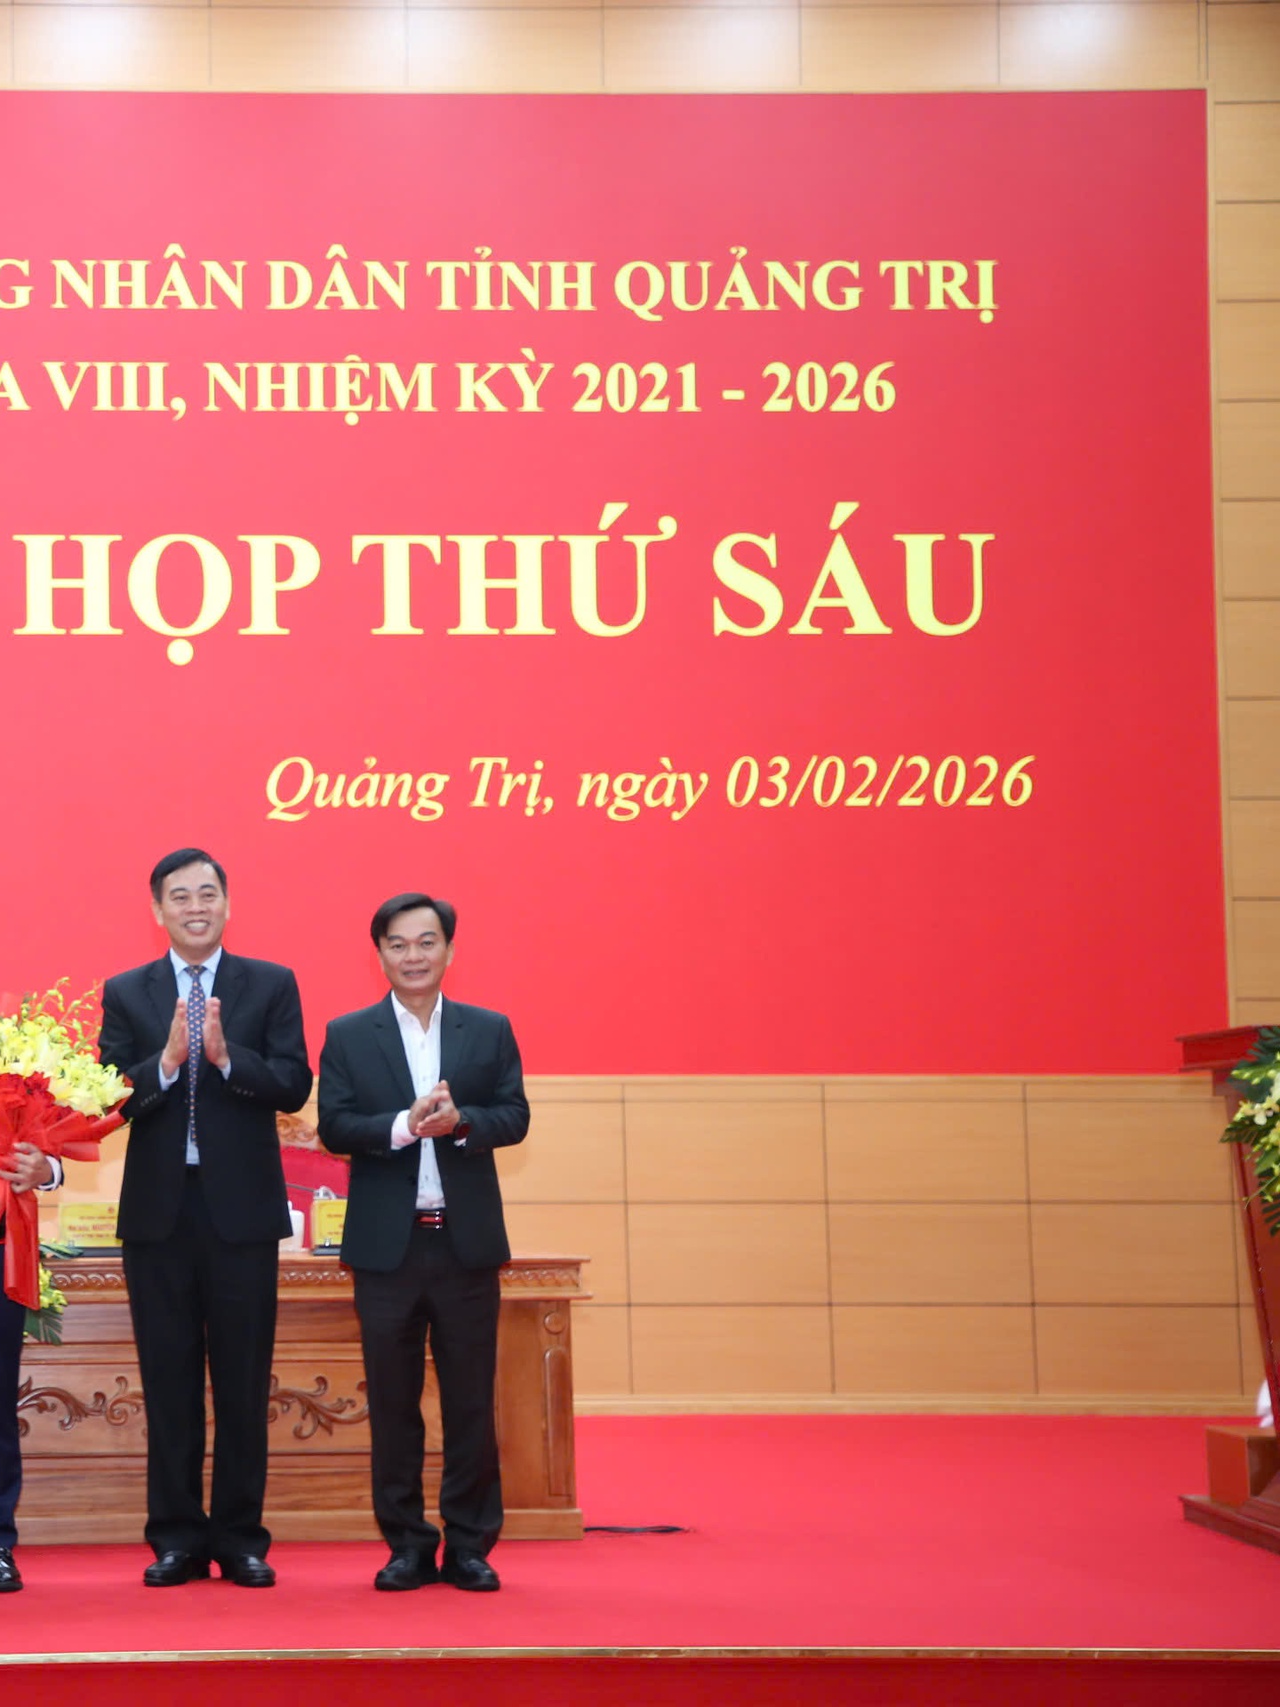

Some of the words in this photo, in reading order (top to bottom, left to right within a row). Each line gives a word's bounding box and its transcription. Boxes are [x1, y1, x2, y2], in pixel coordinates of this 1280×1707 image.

[51, 243, 247, 309] NHÂN
[266, 244, 409, 310] DÂN
[426, 246, 595, 310] TỈNH
[615, 247, 862, 321] QUẢNG
[880, 261, 996, 323] TRỊ
[43, 362, 186, 420] VIII,
[204, 355, 437, 425] NHIỆM
[456, 348, 554, 412] KỲ
[572, 362, 700, 412] 2021
[722, 390, 744, 400] -
[763, 362, 895, 412] 2026
[13, 534, 320, 665] HỌP
[352, 503, 677, 637] THỨ
[713, 502, 994, 637] SÁU
[266, 757, 450, 821] Quảng
[470, 757, 553, 816] Trị,
[577, 757, 708, 821] ngày
[727, 756, 1033, 808] 03/02/2026
